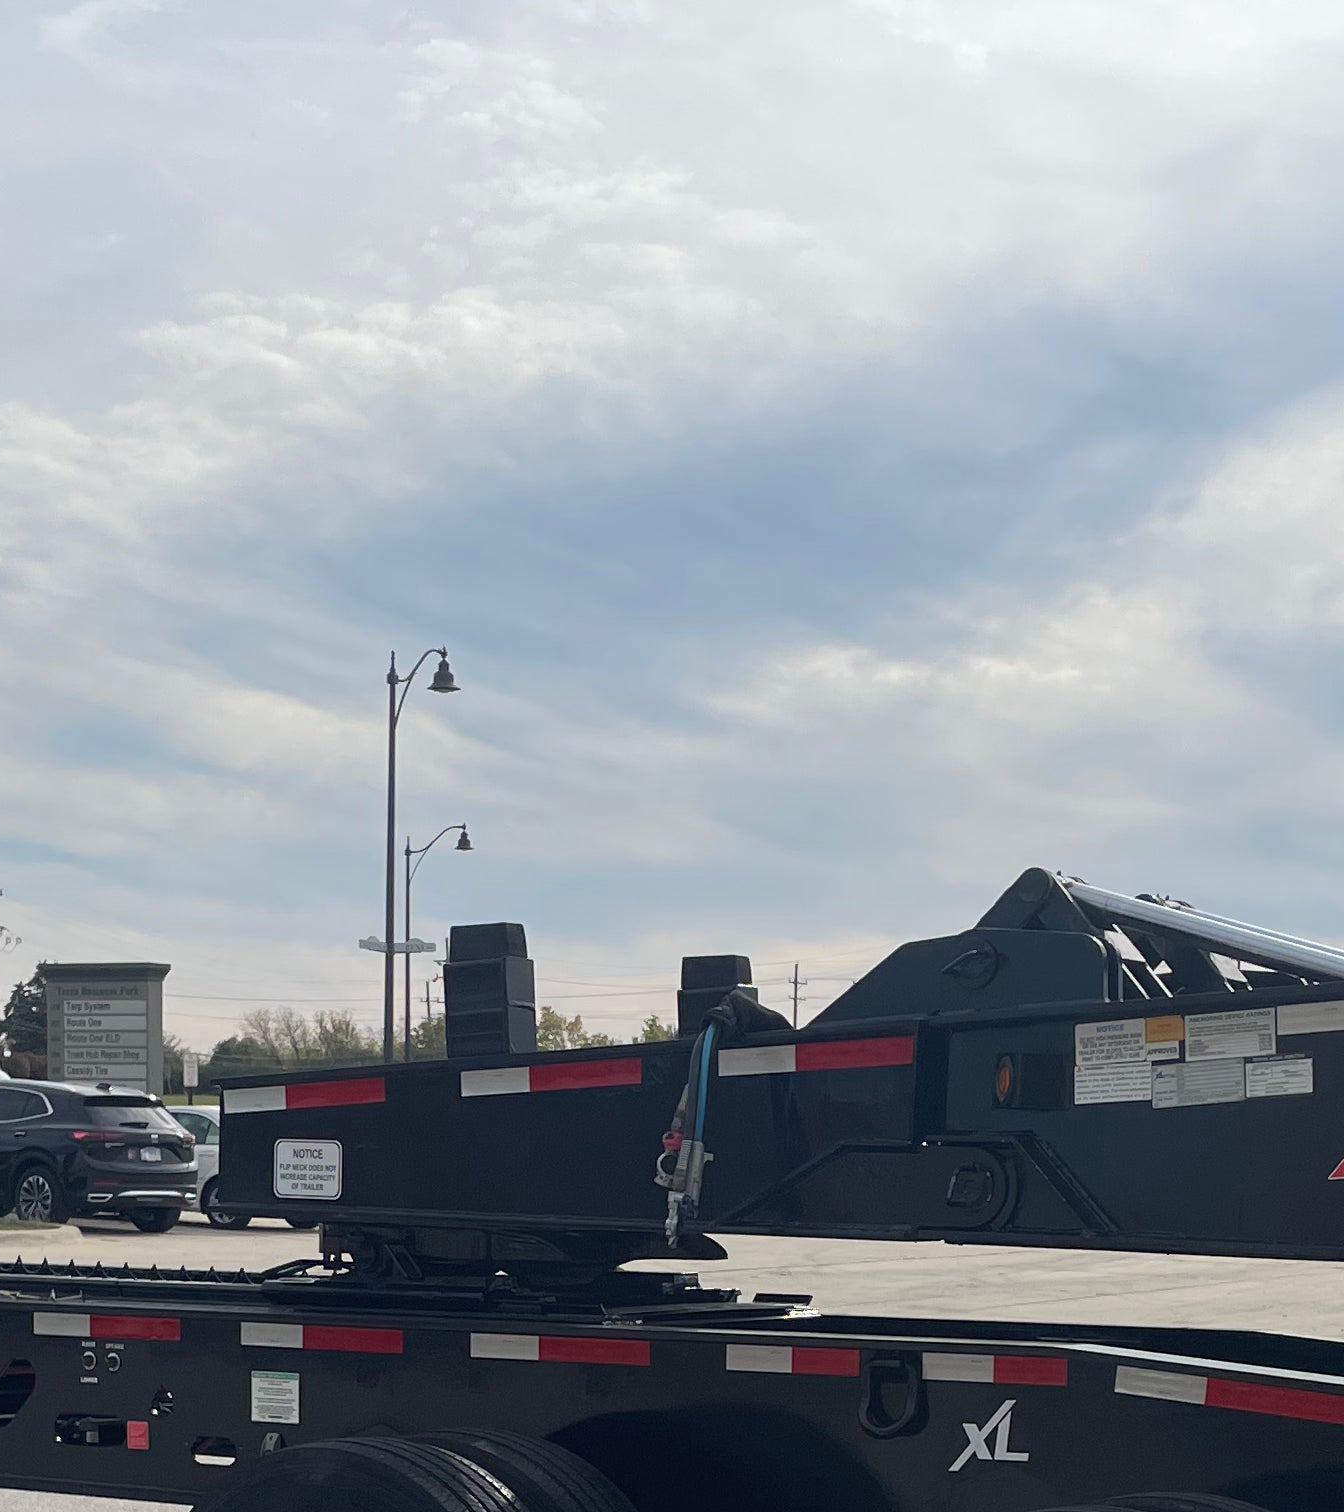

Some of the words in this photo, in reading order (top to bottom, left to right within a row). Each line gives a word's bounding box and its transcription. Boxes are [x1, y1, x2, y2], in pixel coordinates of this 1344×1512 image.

[120, 985, 139, 996] Park
[84, 1002, 111, 1012] System
[88, 1018, 102, 1027] One
[1096, 1024, 1124, 1033] NOTICE
[89, 1034, 103, 1043] One
[1147, 1047, 1178, 1055] APPROVED
[66, 1066, 93, 1076] Cassidy
[95, 1066, 108, 1075] Tire
[293, 1148, 323, 1159] NOTICE
[280, 1163, 291, 1171] FLIP
[300, 1183, 324, 1191] TRAILER
[948, 1399, 1030, 1472] XL
